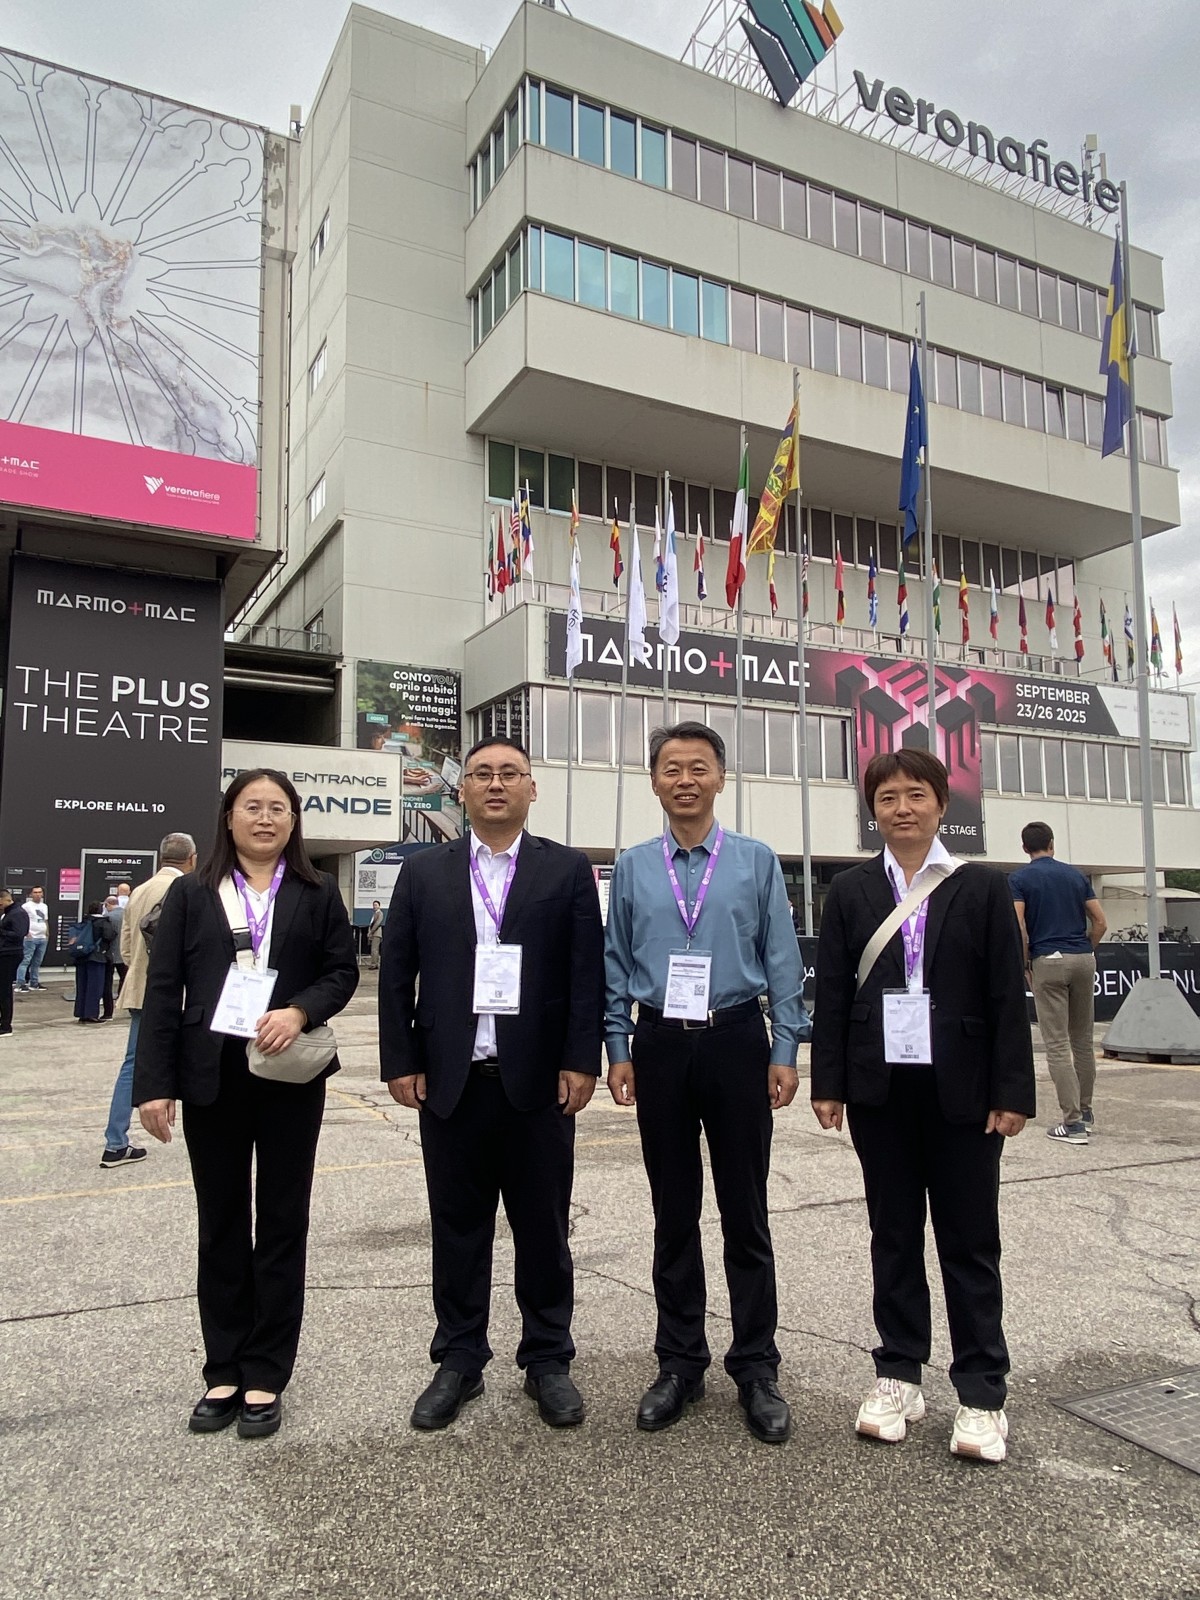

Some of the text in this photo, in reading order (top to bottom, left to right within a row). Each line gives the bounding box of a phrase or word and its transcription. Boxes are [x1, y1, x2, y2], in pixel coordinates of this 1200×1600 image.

[853, 69, 1120, 213] veronafiere
[165, 485, 220, 501] veronafiere
[37, 589, 196, 622] MARMO+MAC
[15, 666, 210, 709] THE PLUS
[389, 682, 457, 695] aprilo subito!
[1015, 683, 1090, 705] SEPTEMBER
[402, 692, 457, 705] Per te tanti
[408, 704, 457, 716] vantaggi.
[1016, 703, 1087, 723] 23/26 2025
[13, 702, 209, 743] THEATRE
[293, 772, 387, 787] ENTRANCE
[55, 799, 165, 813] EXPLORE HALL 10
[298, 795, 392, 815] ANDE
[949, 825, 977, 836] STAGE
